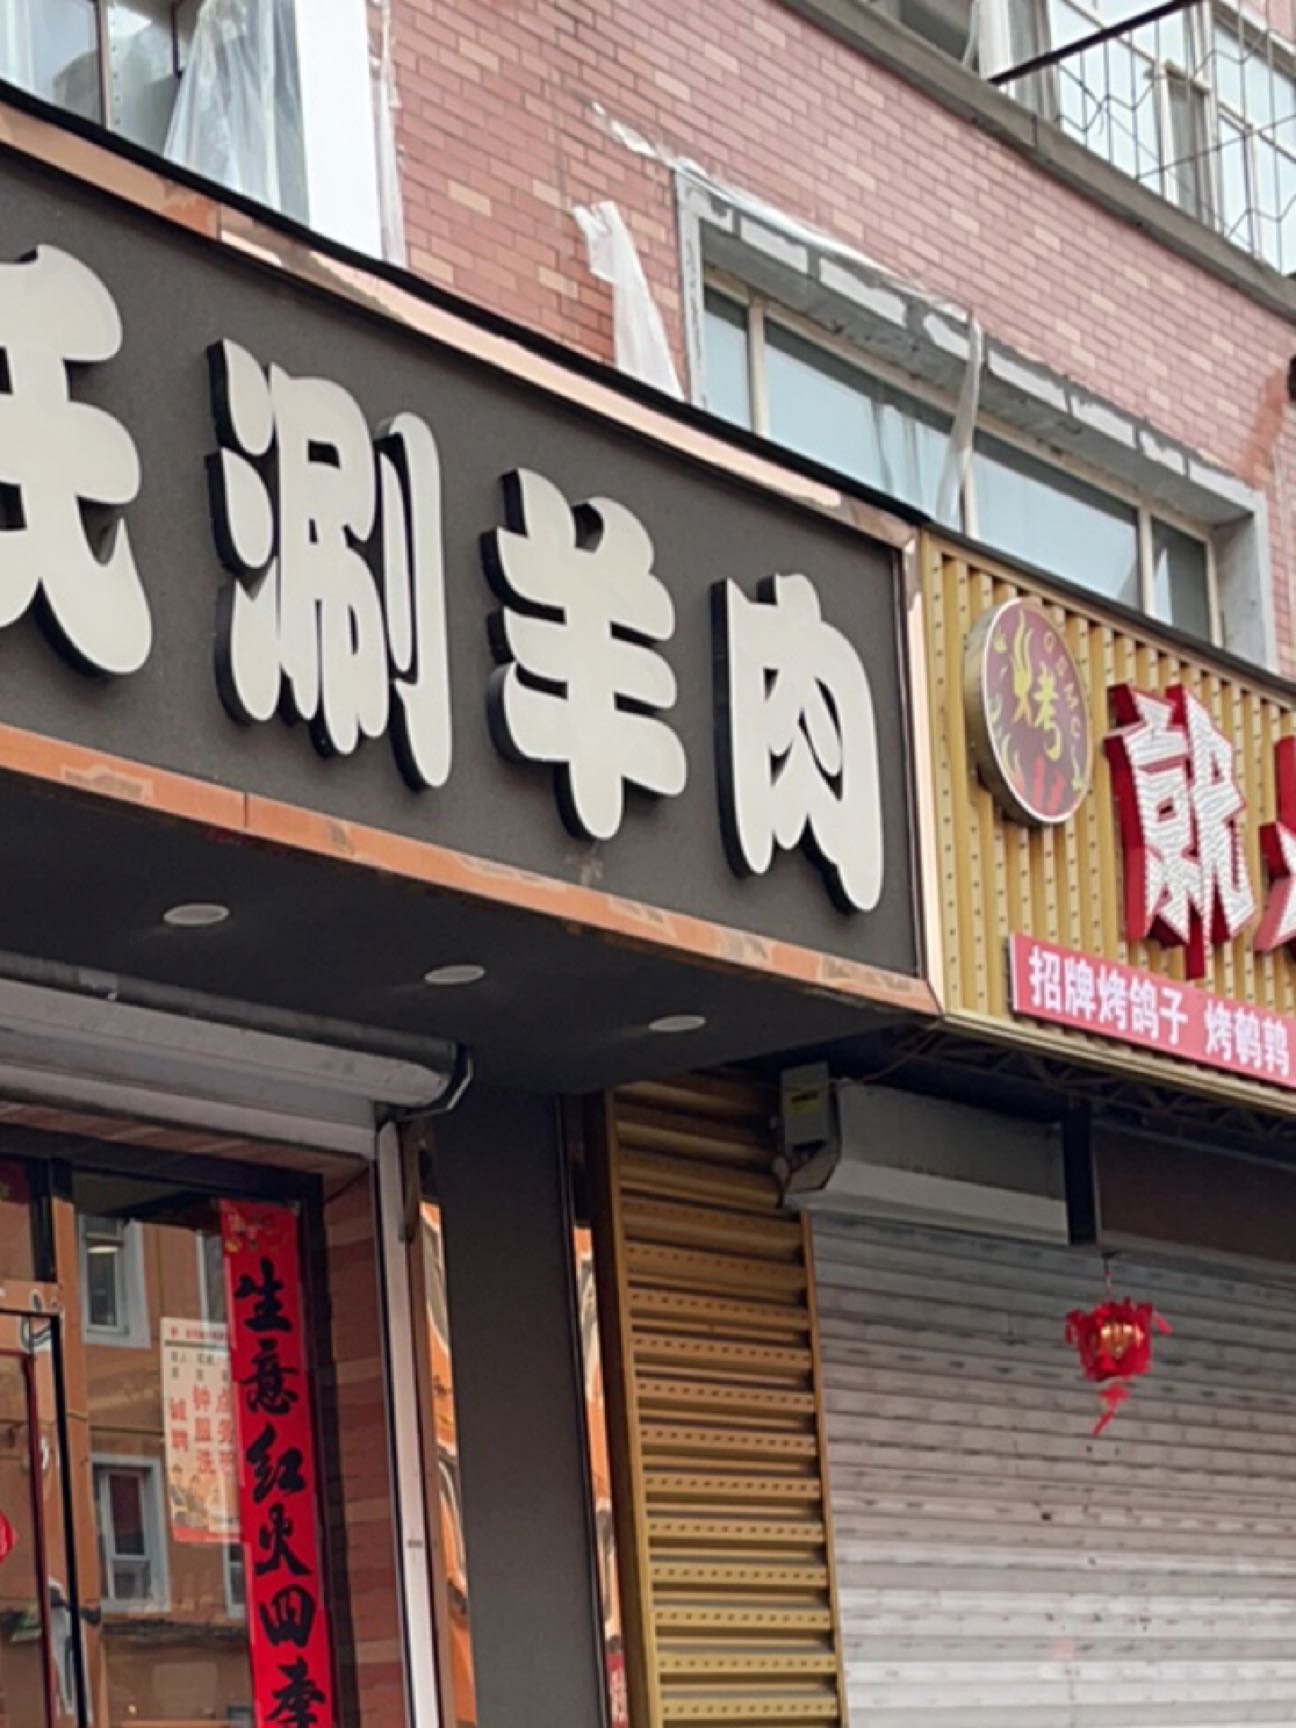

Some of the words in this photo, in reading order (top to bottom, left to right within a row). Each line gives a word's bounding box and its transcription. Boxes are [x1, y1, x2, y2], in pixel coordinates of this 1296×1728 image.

[1106, 682, 1296, 980] 就
[1028, 944, 1189, 1045] 招牌烤鸽子
[1204, 999, 1291, 1077] 烤鹌鹑
